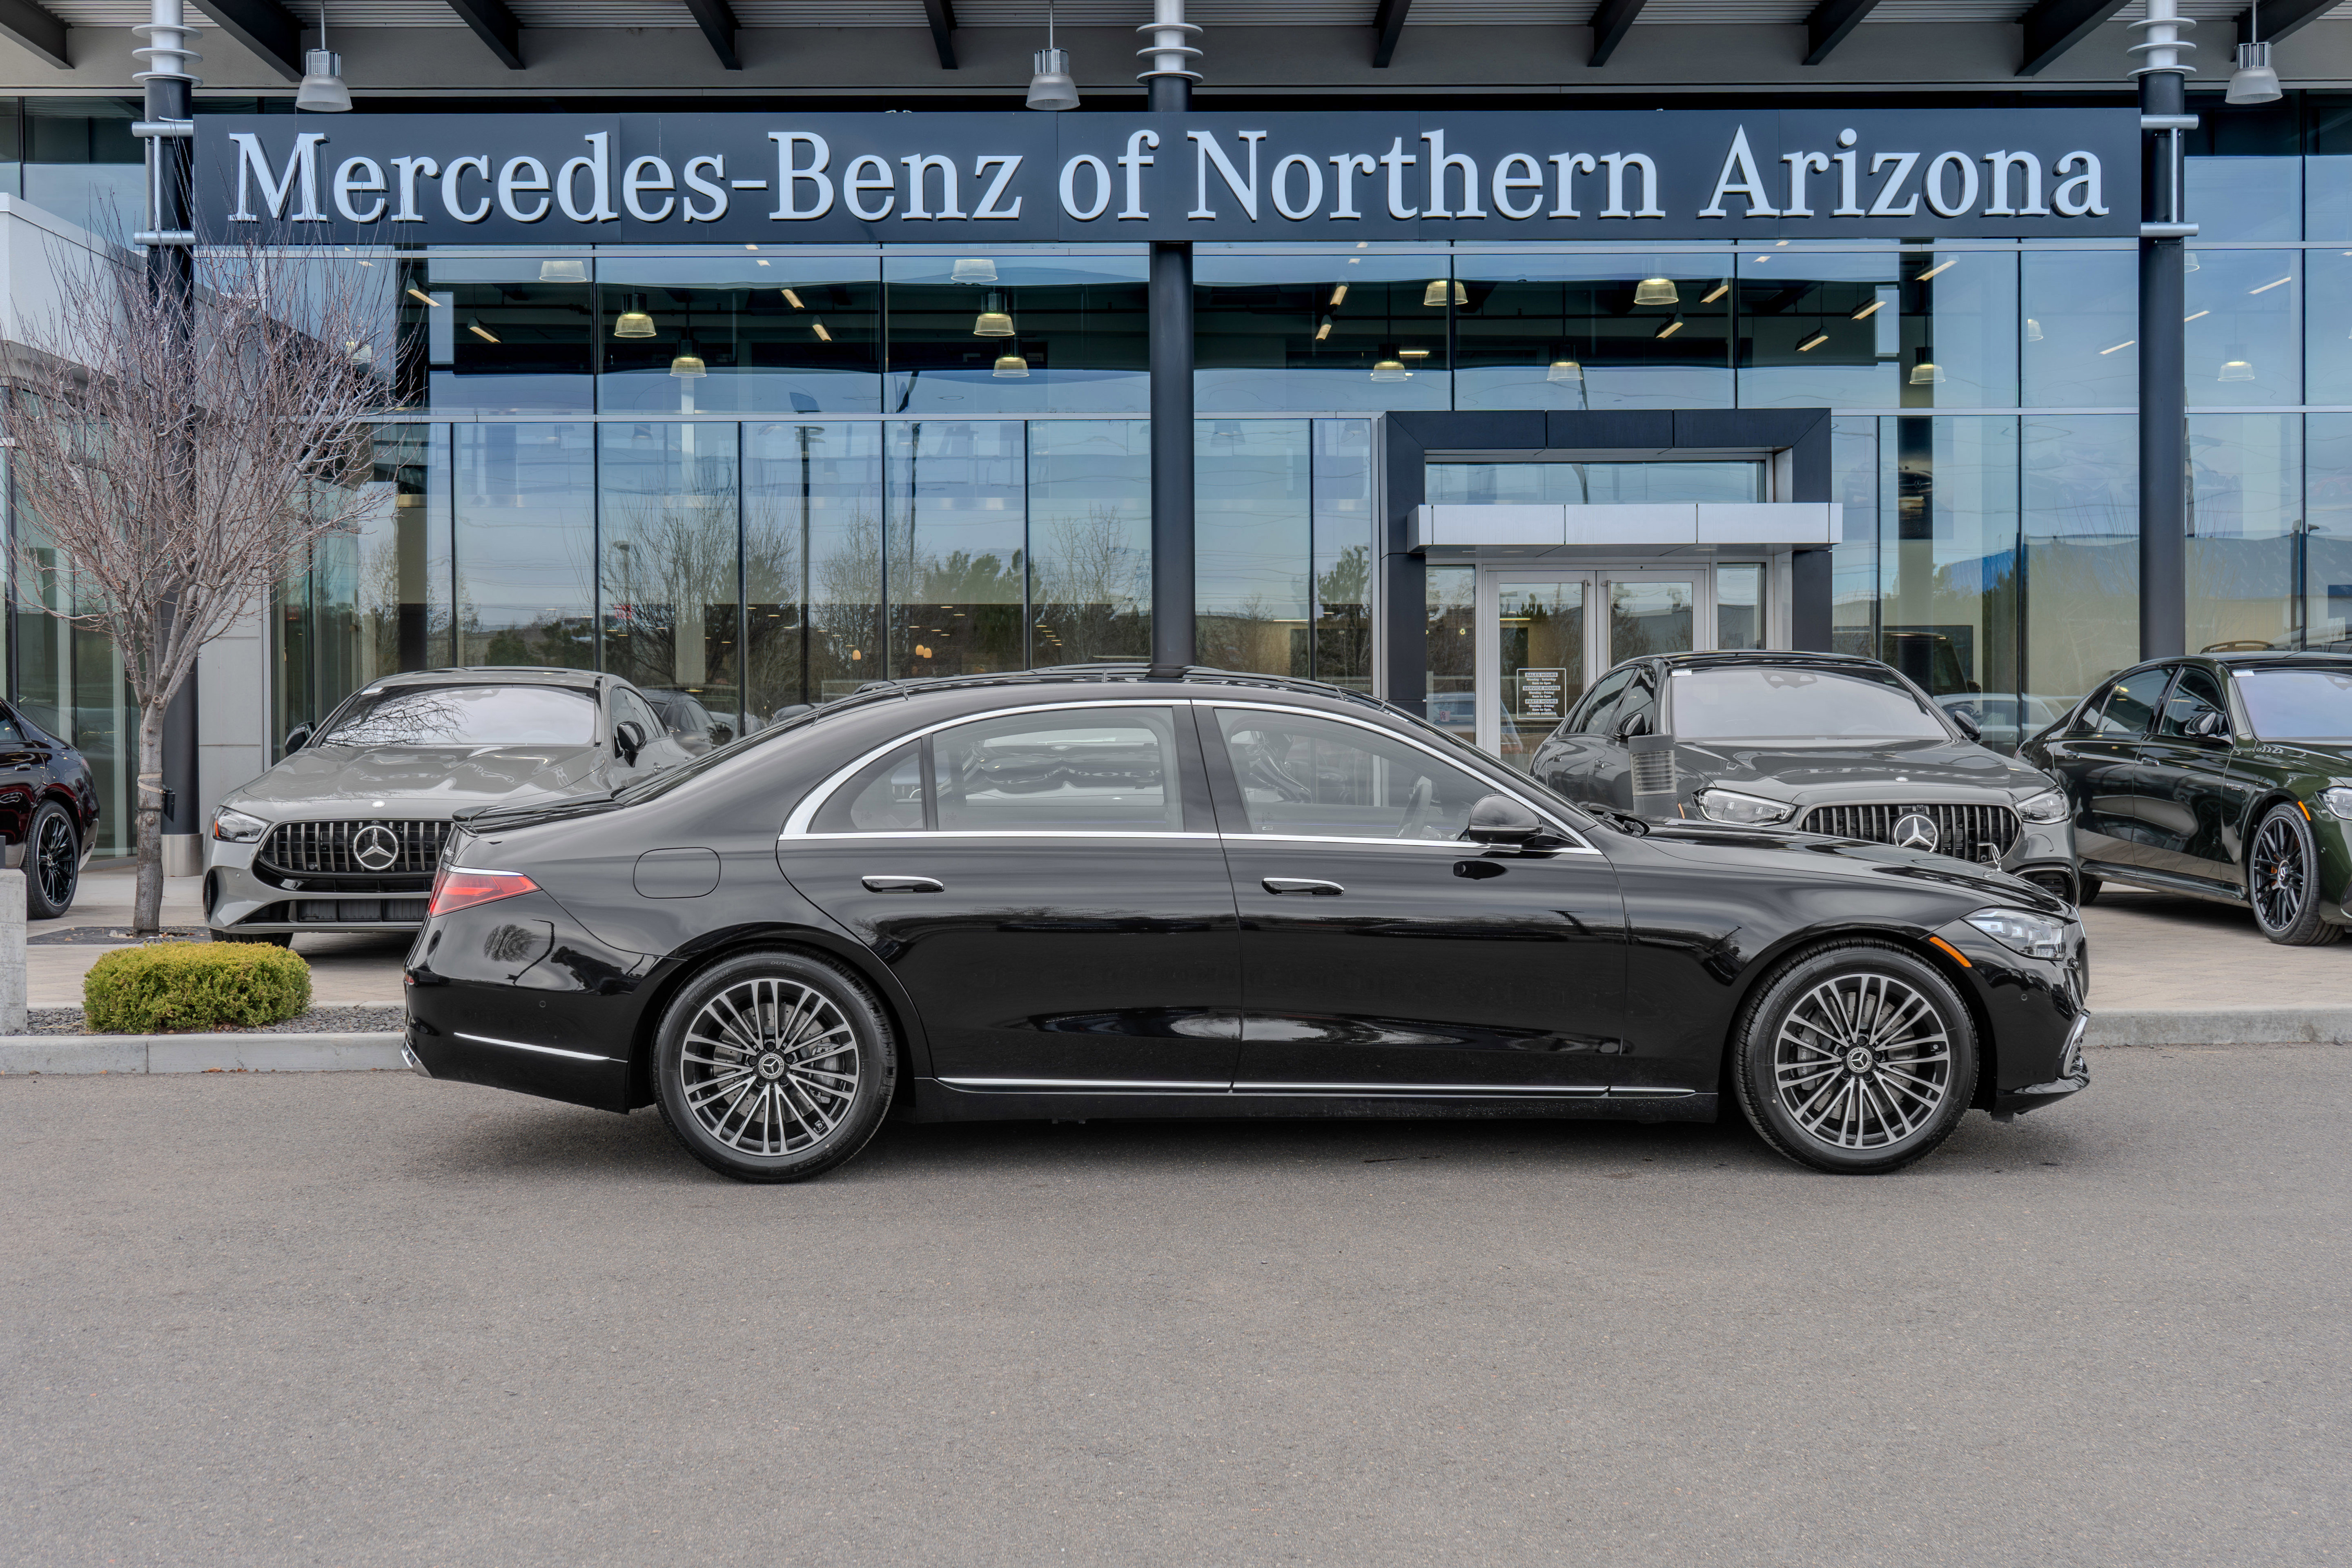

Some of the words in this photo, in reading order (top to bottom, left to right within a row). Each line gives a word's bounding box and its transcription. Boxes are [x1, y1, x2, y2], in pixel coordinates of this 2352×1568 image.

[228, 131, 1023, 223] Mercedes-Benz
[1059, 129, 1160, 222] of
[1187, 128, 1666, 221] Northern
[1696, 123, 2109, 218] Arizona
[771, 961, 805, 969] OUTSIDE
